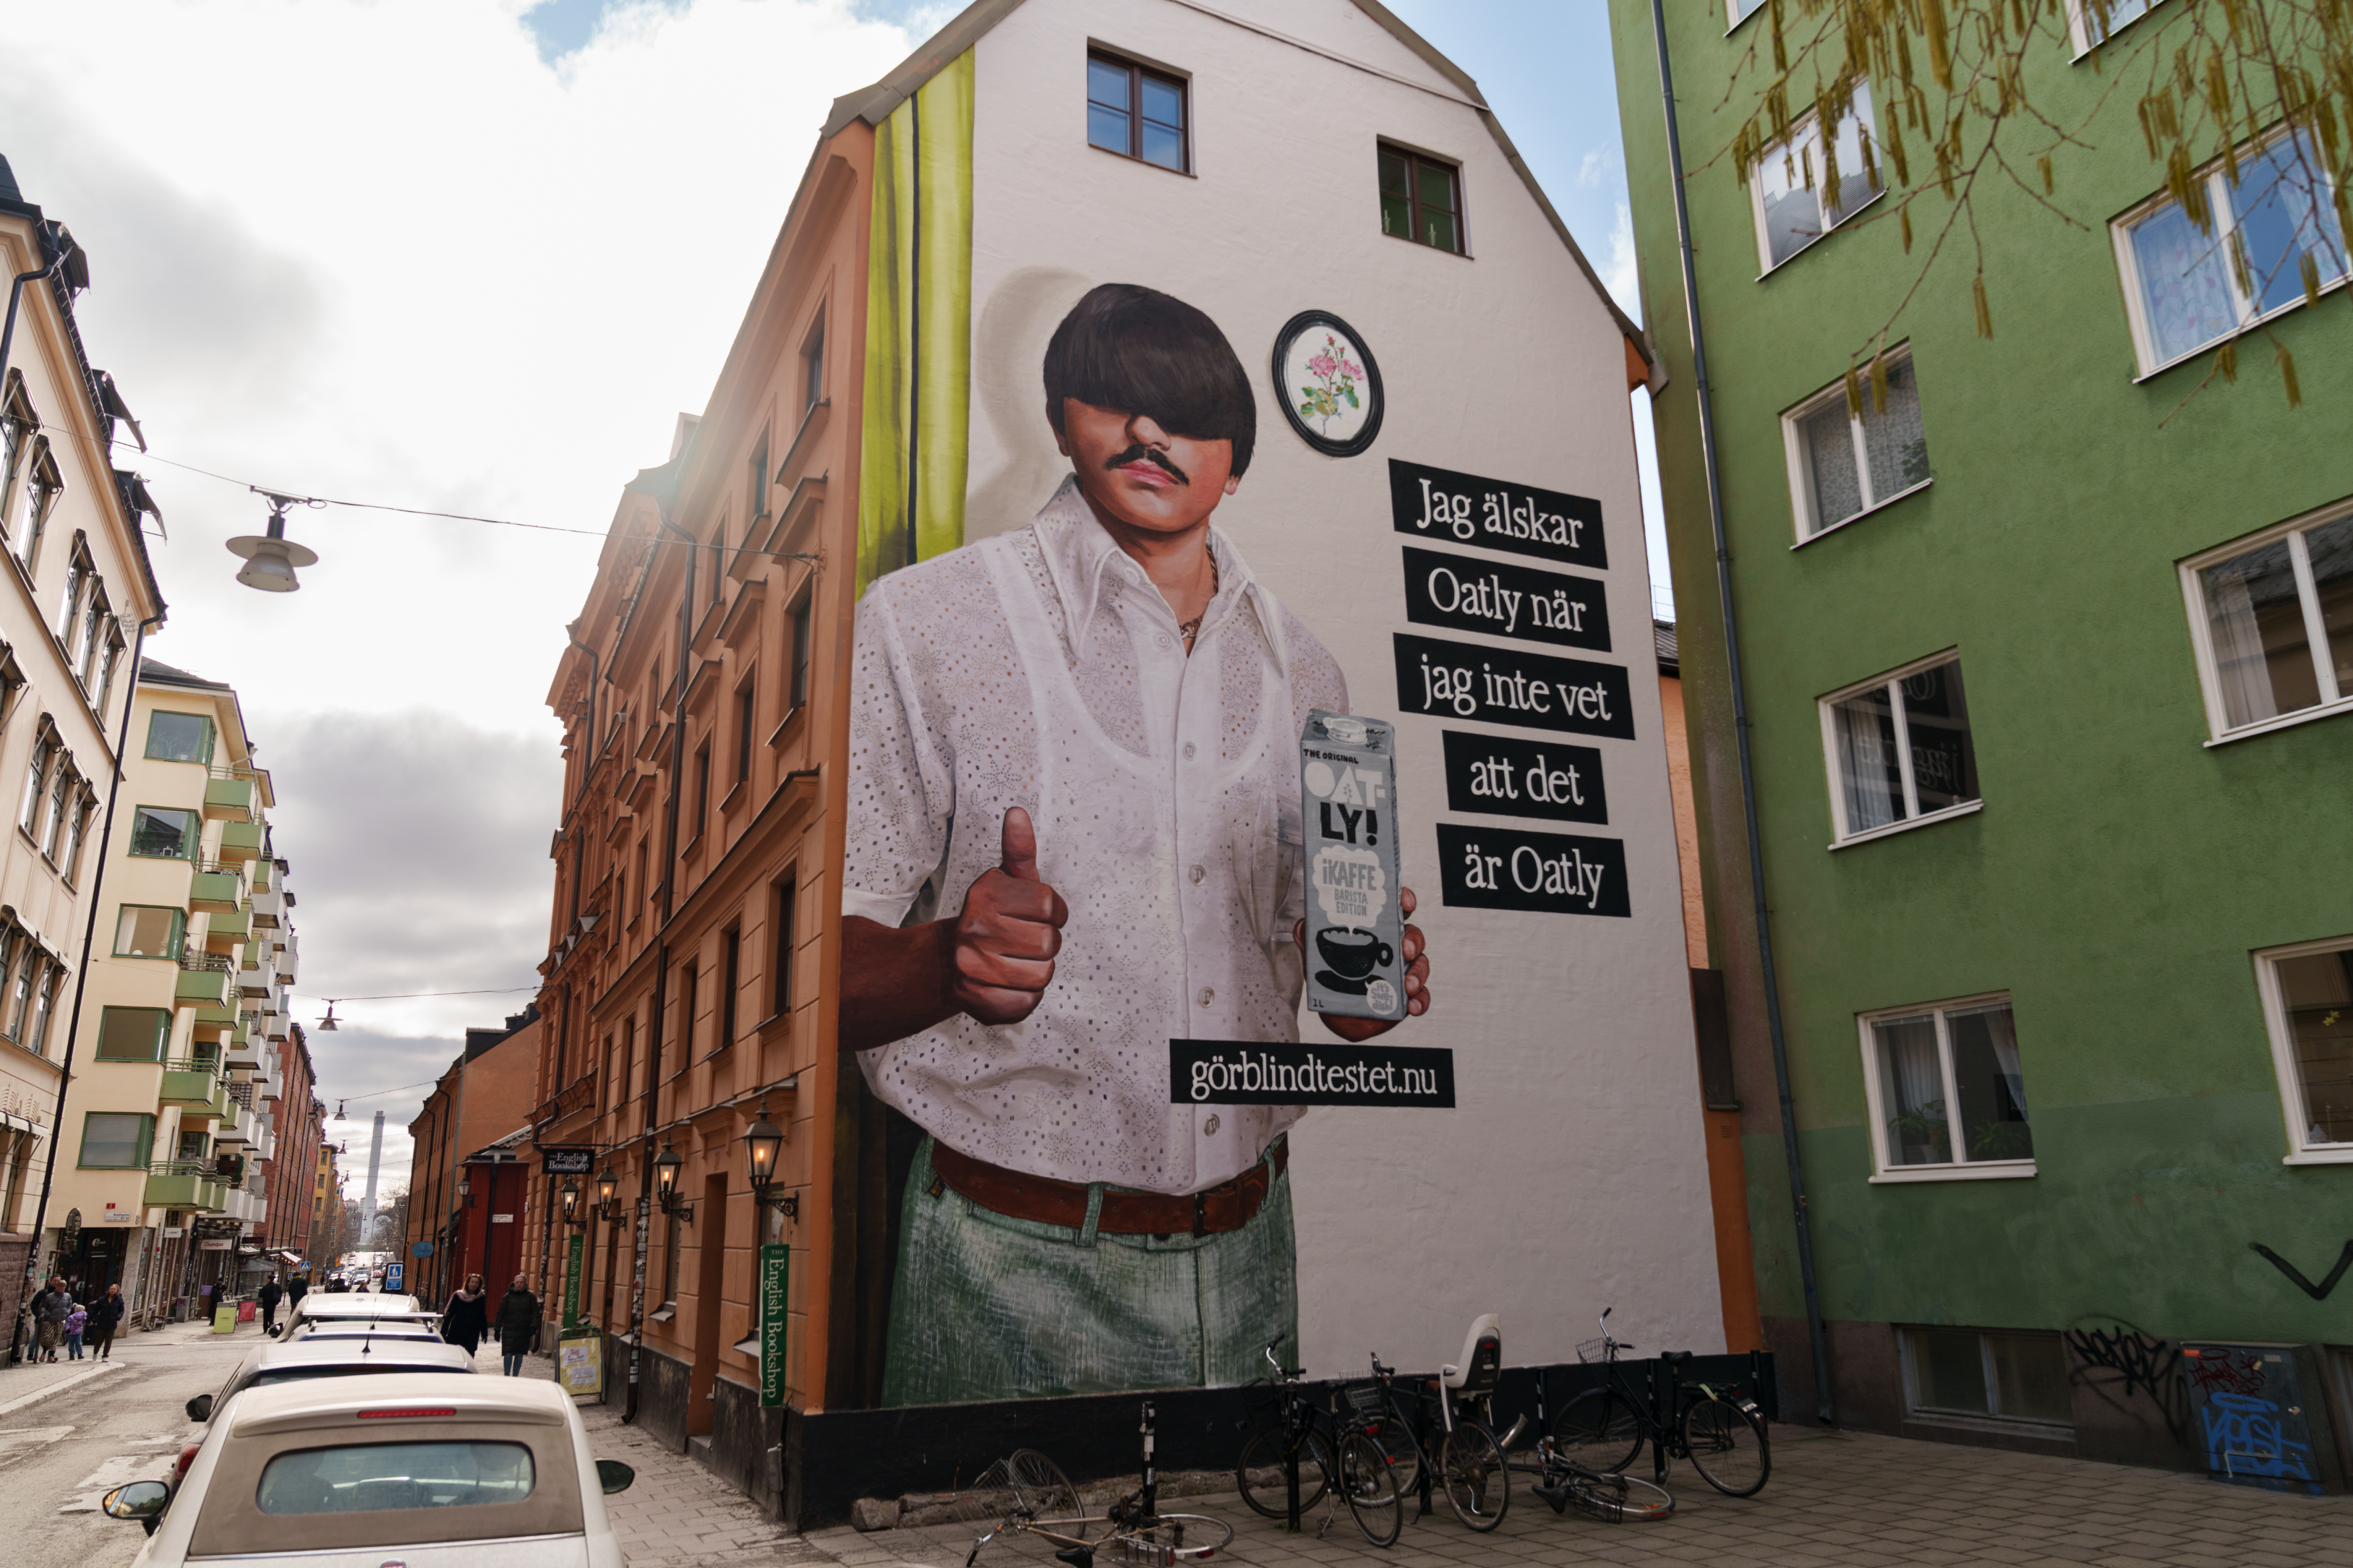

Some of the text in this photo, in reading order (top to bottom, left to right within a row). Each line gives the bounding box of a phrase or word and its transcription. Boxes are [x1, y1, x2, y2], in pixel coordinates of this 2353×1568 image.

[1417, 478, 1584, 549] Jag älskar
[1427, 567, 1587, 633] Oatly när
[1421, 653, 1613, 721] jag inte vet
[1303, 748, 1359, 764] THE ORIGINAL
[1469, 754, 1584, 806] att det
[1320, 801, 1378, 847] LY!
[1322, 857, 1377, 891] iKAFFE
[1464, 844, 1605, 909] är Oatly
[1334, 888, 1368, 904] BARISTA
[1336, 903, 1367, 917] EDITION
[1312, 998, 1325, 1008] 1L
[1190, 1050, 1438, 1101] görblindtestet.nu
[548, 1160, 589, 1171] Bookshop
[557, 1152, 588, 1164] English
[570, 1246, 581, 1274] English
[565, 1275, 578, 1313] Bookshop
[764, 1257, 785, 1316] English
[763, 1320, 782, 1398] Bookshop
